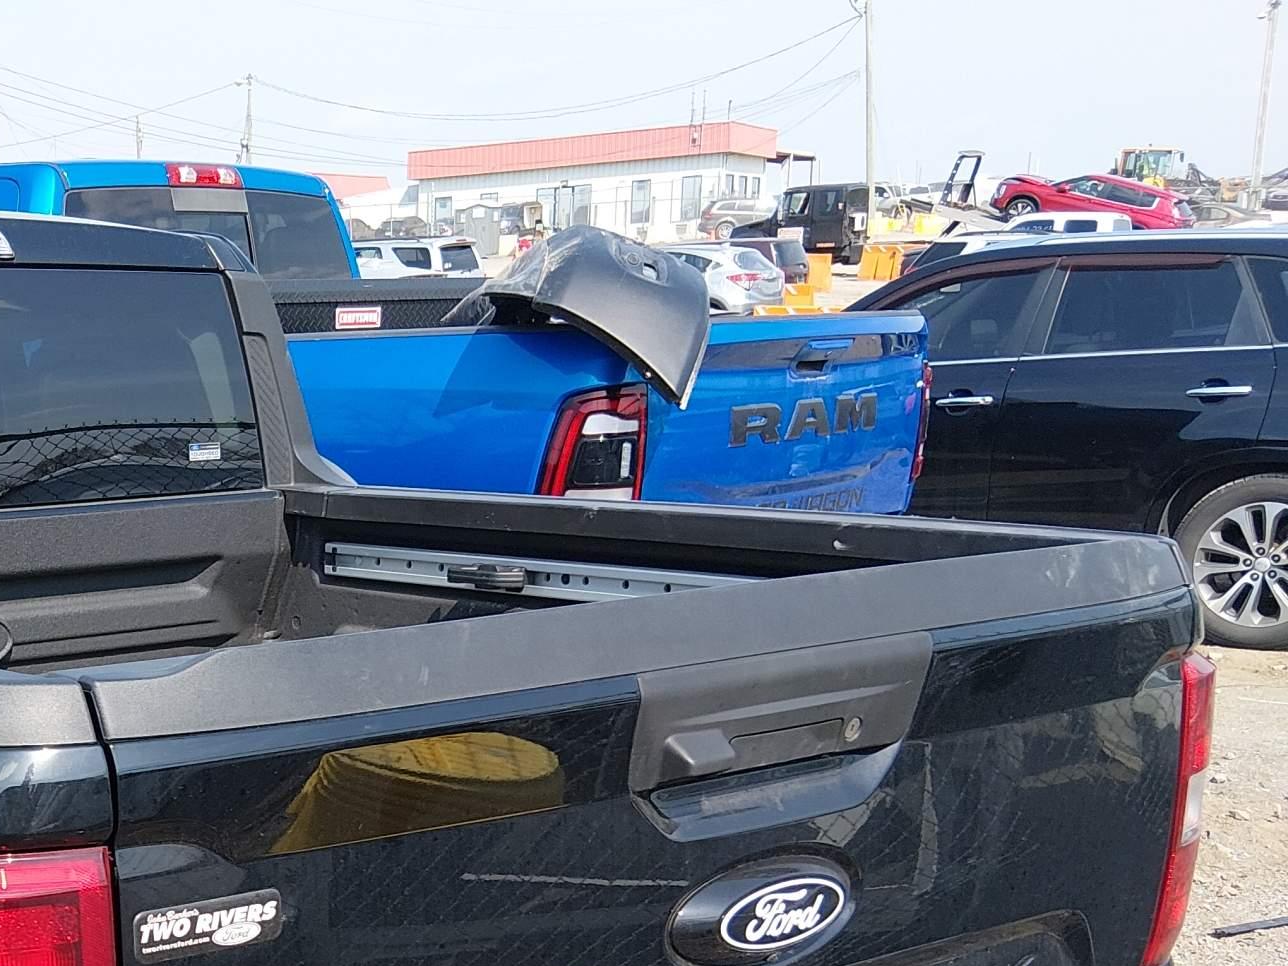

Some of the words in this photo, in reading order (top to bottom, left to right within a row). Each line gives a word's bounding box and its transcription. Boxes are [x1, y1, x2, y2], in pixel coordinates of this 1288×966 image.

[728, 393, 878, 448] RAM
[139, 917, 192, 944] TWO
[195, 900, 278, 934] RIVERS
[744, 888, 825, 942] Ford
